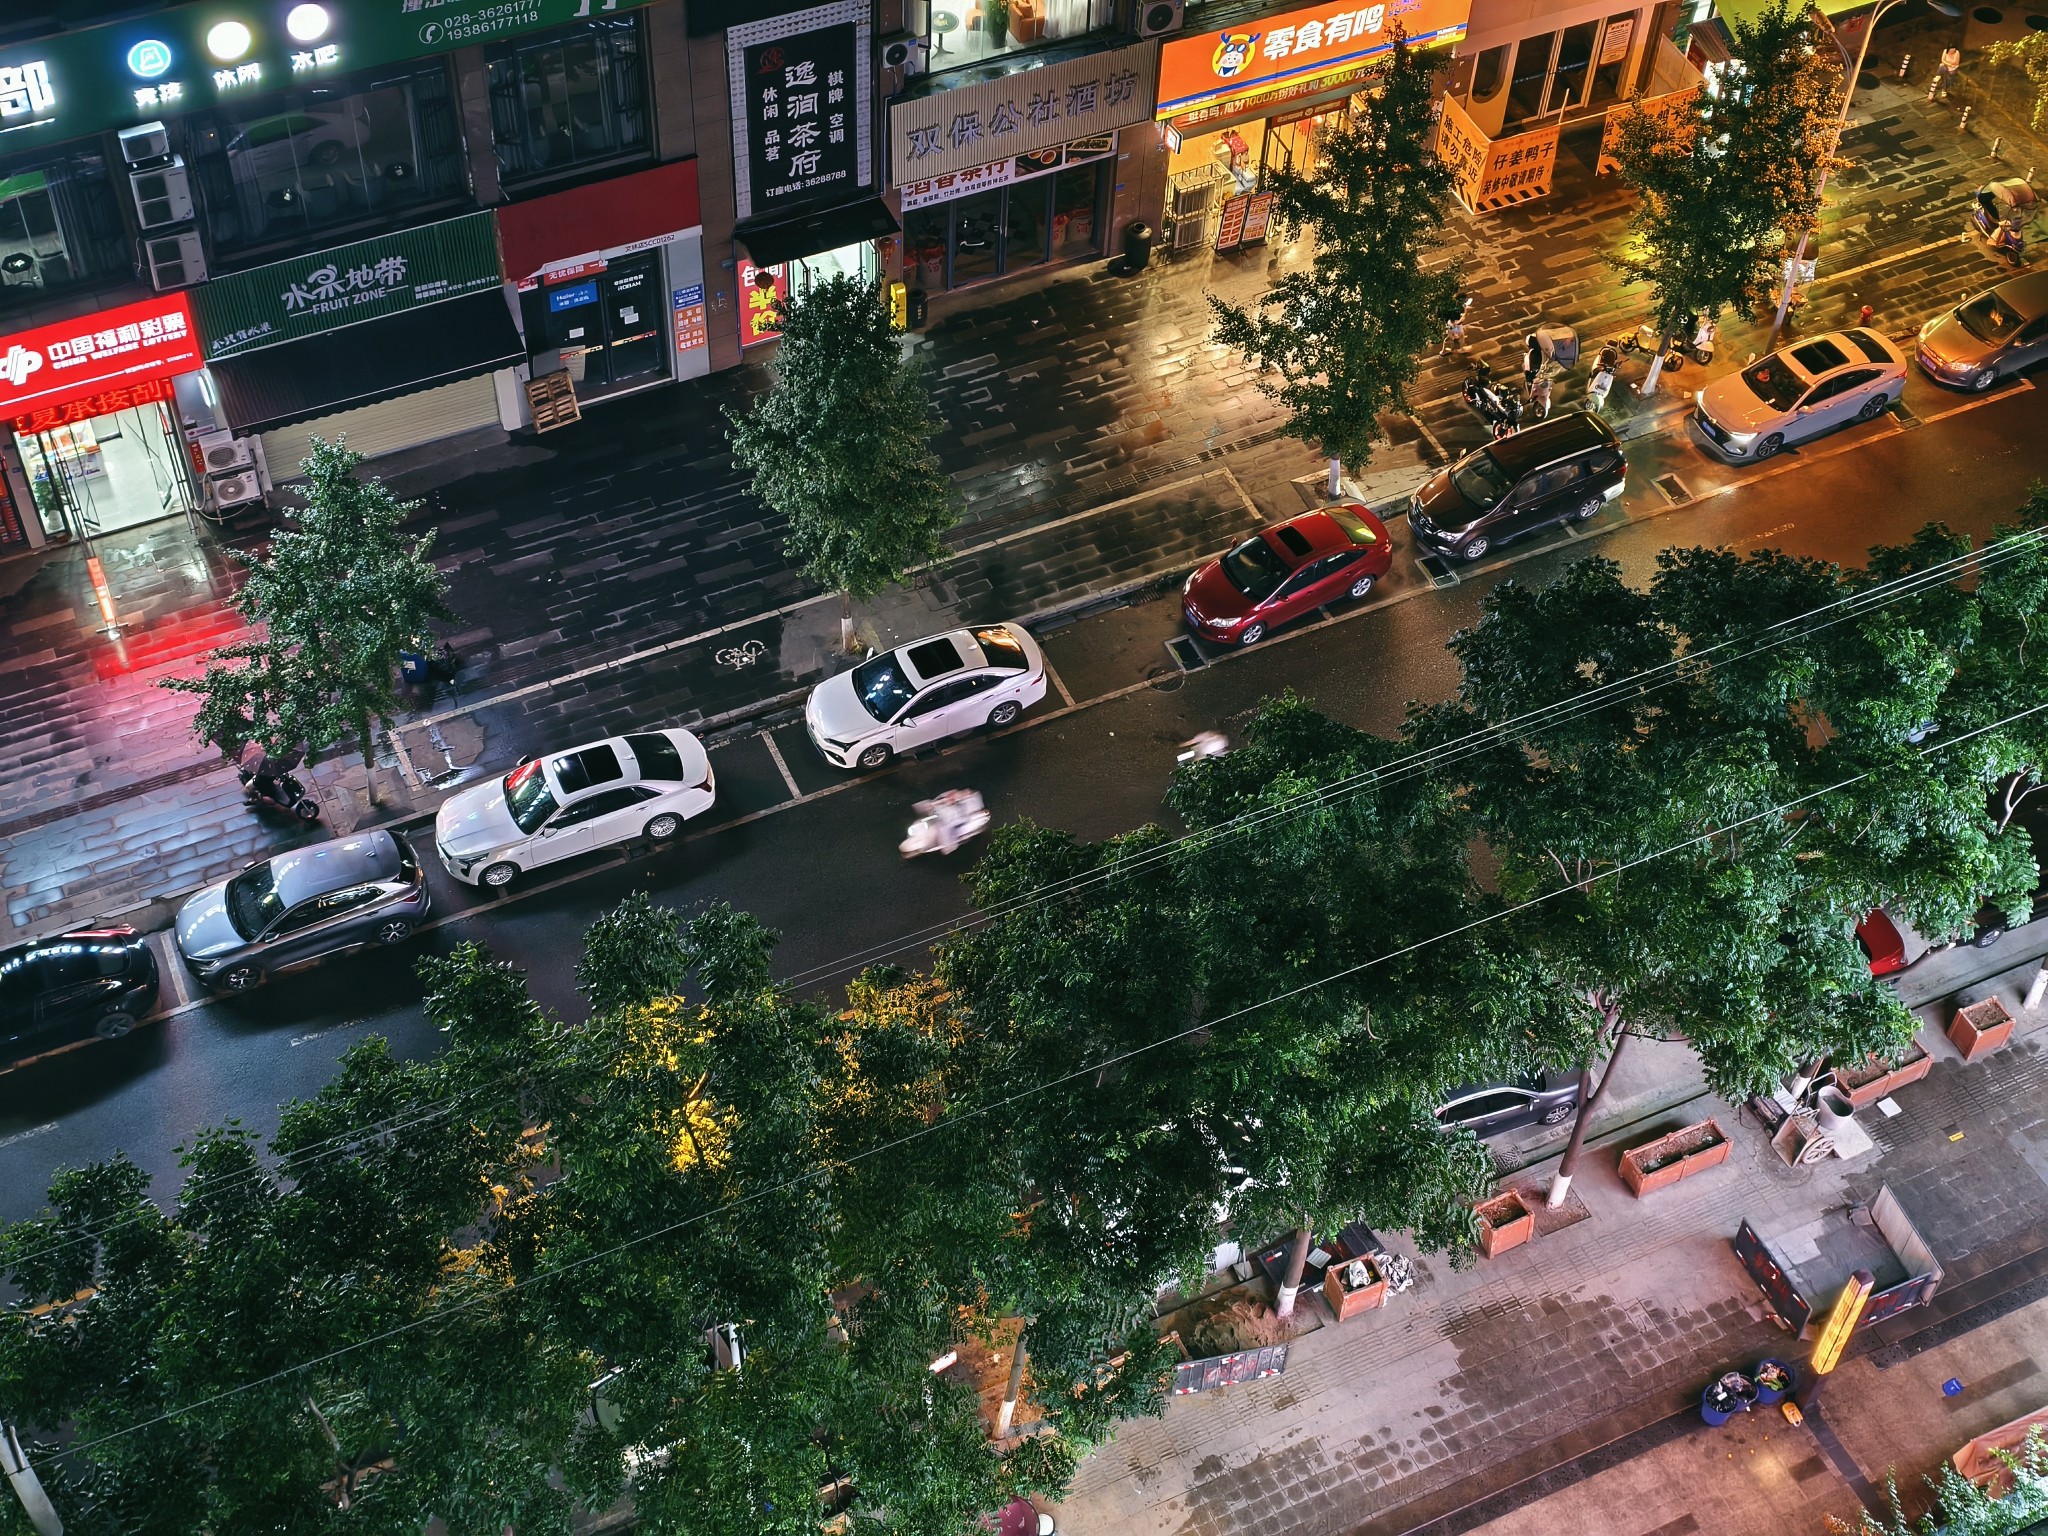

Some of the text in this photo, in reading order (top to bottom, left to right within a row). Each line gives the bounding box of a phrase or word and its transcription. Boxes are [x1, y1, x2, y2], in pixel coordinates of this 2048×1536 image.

[447, 11, 538, 40] 19386177118
[1263, 3, 1386, 61] 零食有鸣
[213, 63, 261, 90] 休闲
[290, 44, 338, 72] 水吧
[763, 86, 780, 161] 休闲 品茗
[785, 60, 822, 177] 逸涧茶府
[828, 70, 844, 144] 棋牌 空调
[906, 69, 1139, 162] 双保公社酒坊
[1440, 131, 1478, 183] 请勿靠近
[1444, 115, 1482, 167] 施工危险
[1493, 141, 1555, 171] 仔姜鸭子
[1482, 165, 1545, 195] 装修中敬请期待
[281, 256, 408, 311] 水果地带
[312, 287, 386, 314] FRUIT ZONE
[47, 311, 187, 361] 中国福利彩票
[53, 329, 187, 369] CHINA WELFARE LOTTERY
